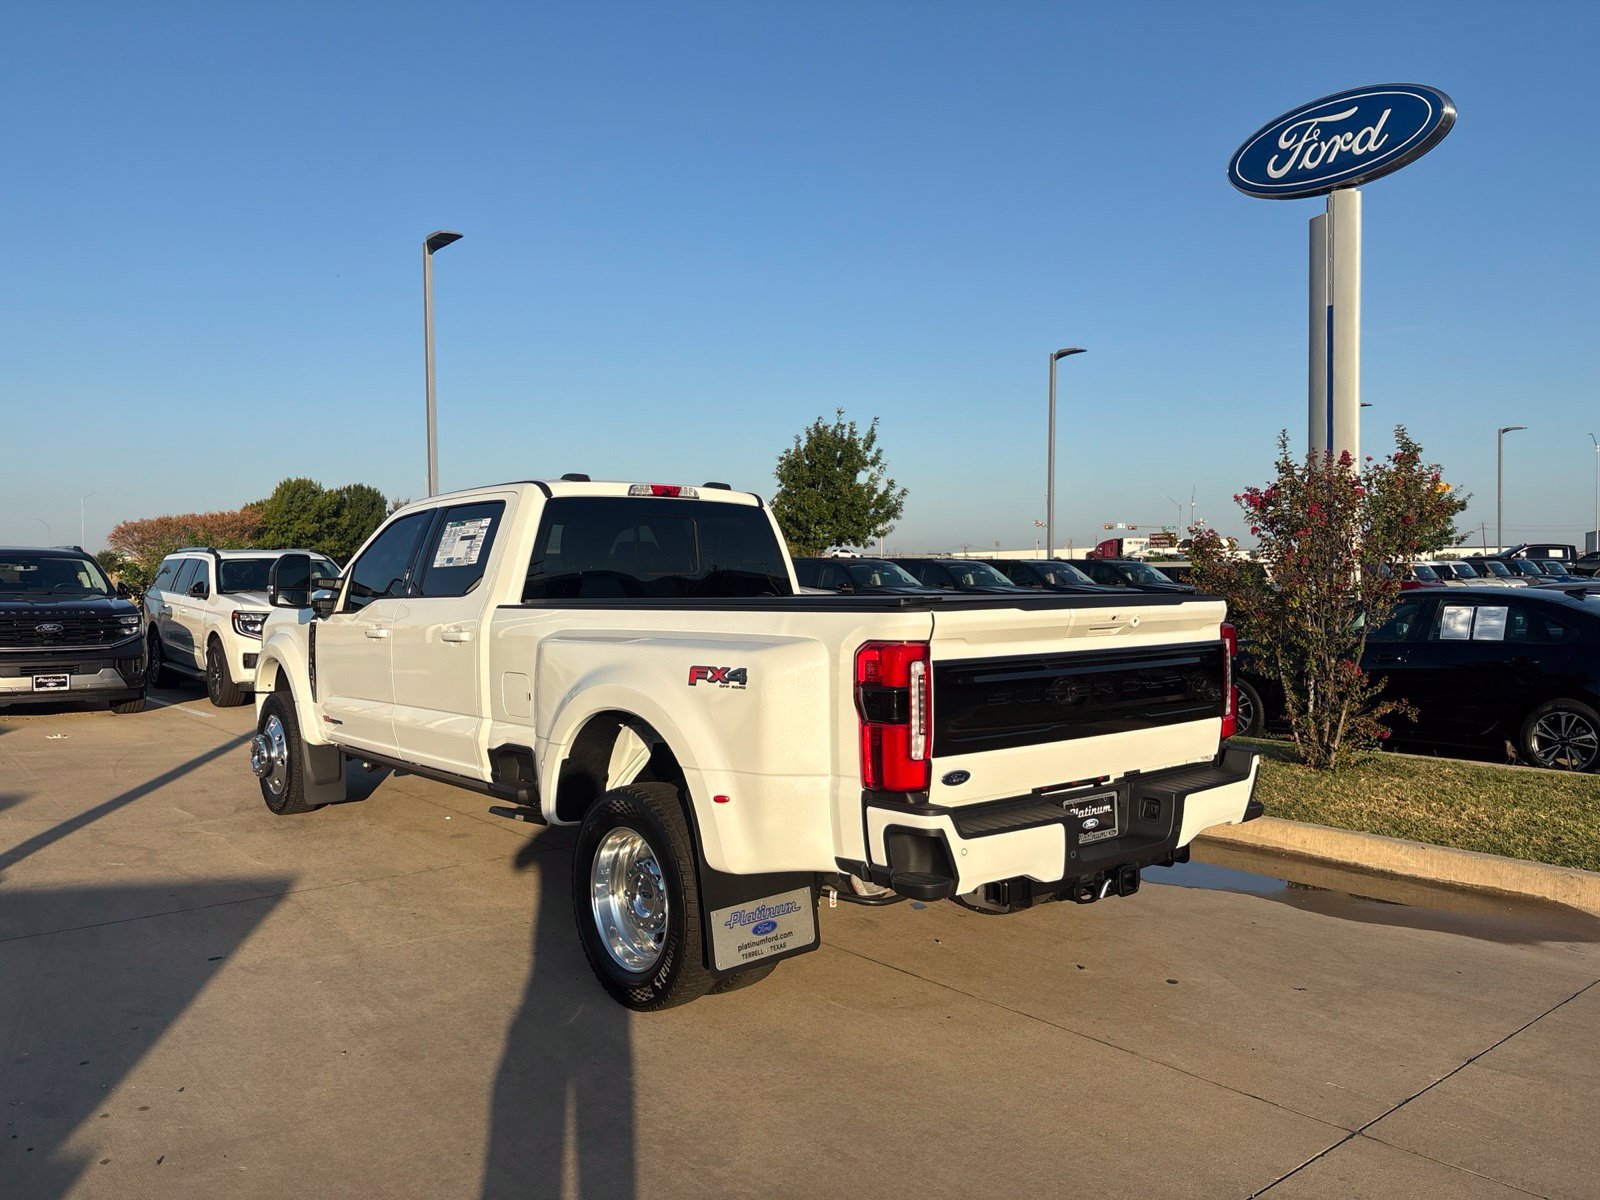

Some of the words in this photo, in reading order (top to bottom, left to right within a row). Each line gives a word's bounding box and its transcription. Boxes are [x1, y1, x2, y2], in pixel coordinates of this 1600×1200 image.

[1267, 106, 1392, 179] Ford
[688, 665, 748, 686] FX4
[725, 901, 801, 929] Platinum
[756, 922, 774, 934] Ford
[738, 931, 794, 953] platinumford.com
[742, 949, 764, 960] TERRELL
[769, 942, 787, 952] TEXAS
